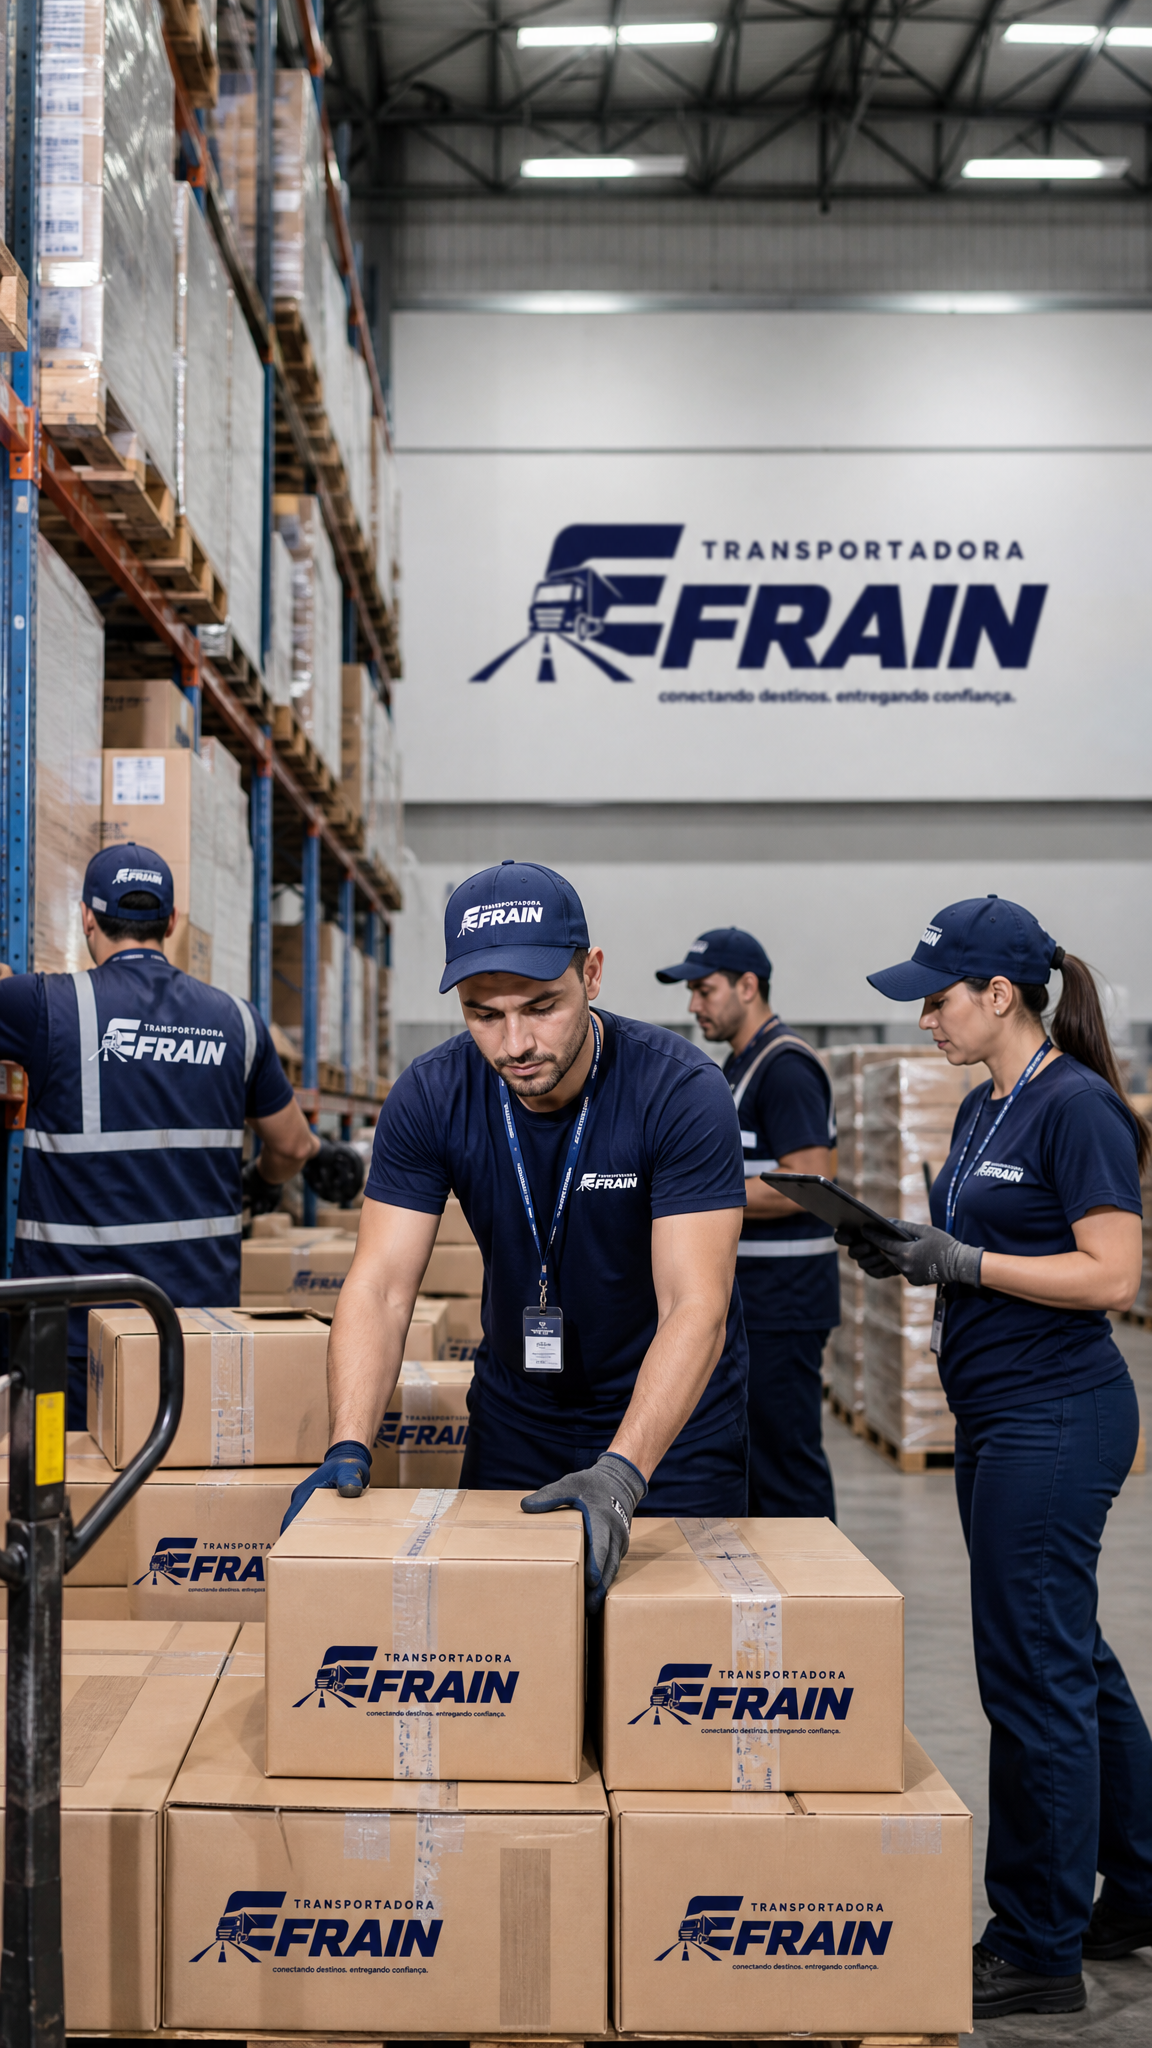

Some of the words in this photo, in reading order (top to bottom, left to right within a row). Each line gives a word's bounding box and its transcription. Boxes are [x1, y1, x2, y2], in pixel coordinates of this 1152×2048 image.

[702, 540, 1024, 560] TRANSPORTADORA
[528, 523, 1049, 669] EFRAIN
[658, 688, 755, 703] conectando
[759, 688, 832, 703] destinos.
[835, 688, 929, 707] entregando
[461, 905, 543, 929] EFRAIN
[143, 1023, 224, 1037] TRANSPORTADORA
[102, 1017, 227, 1066] EFRAIN
[580, 1173, 638, 1190] EFRAIN
[384, 1653, 512, 1663] TRANSPORTADORA
[315, 1645, 520, 1704] EFRAIN
[718, 1670, 846, 1680] TRANSPORTADORA
[649, 1663, 855, 1720] EFRAIN
[435, 1710, 473, 1719] entregando
[294, 1899, 435, 1910] TRANSPORTADORA
[750, 1903, 884, 1912] TRANSPORTADORA
[215, 1890, 444, 1957] EFRAIN
[677, 1895, 894, 1956] EFRAIN
[349, 1966, 391, 1975] entregando
